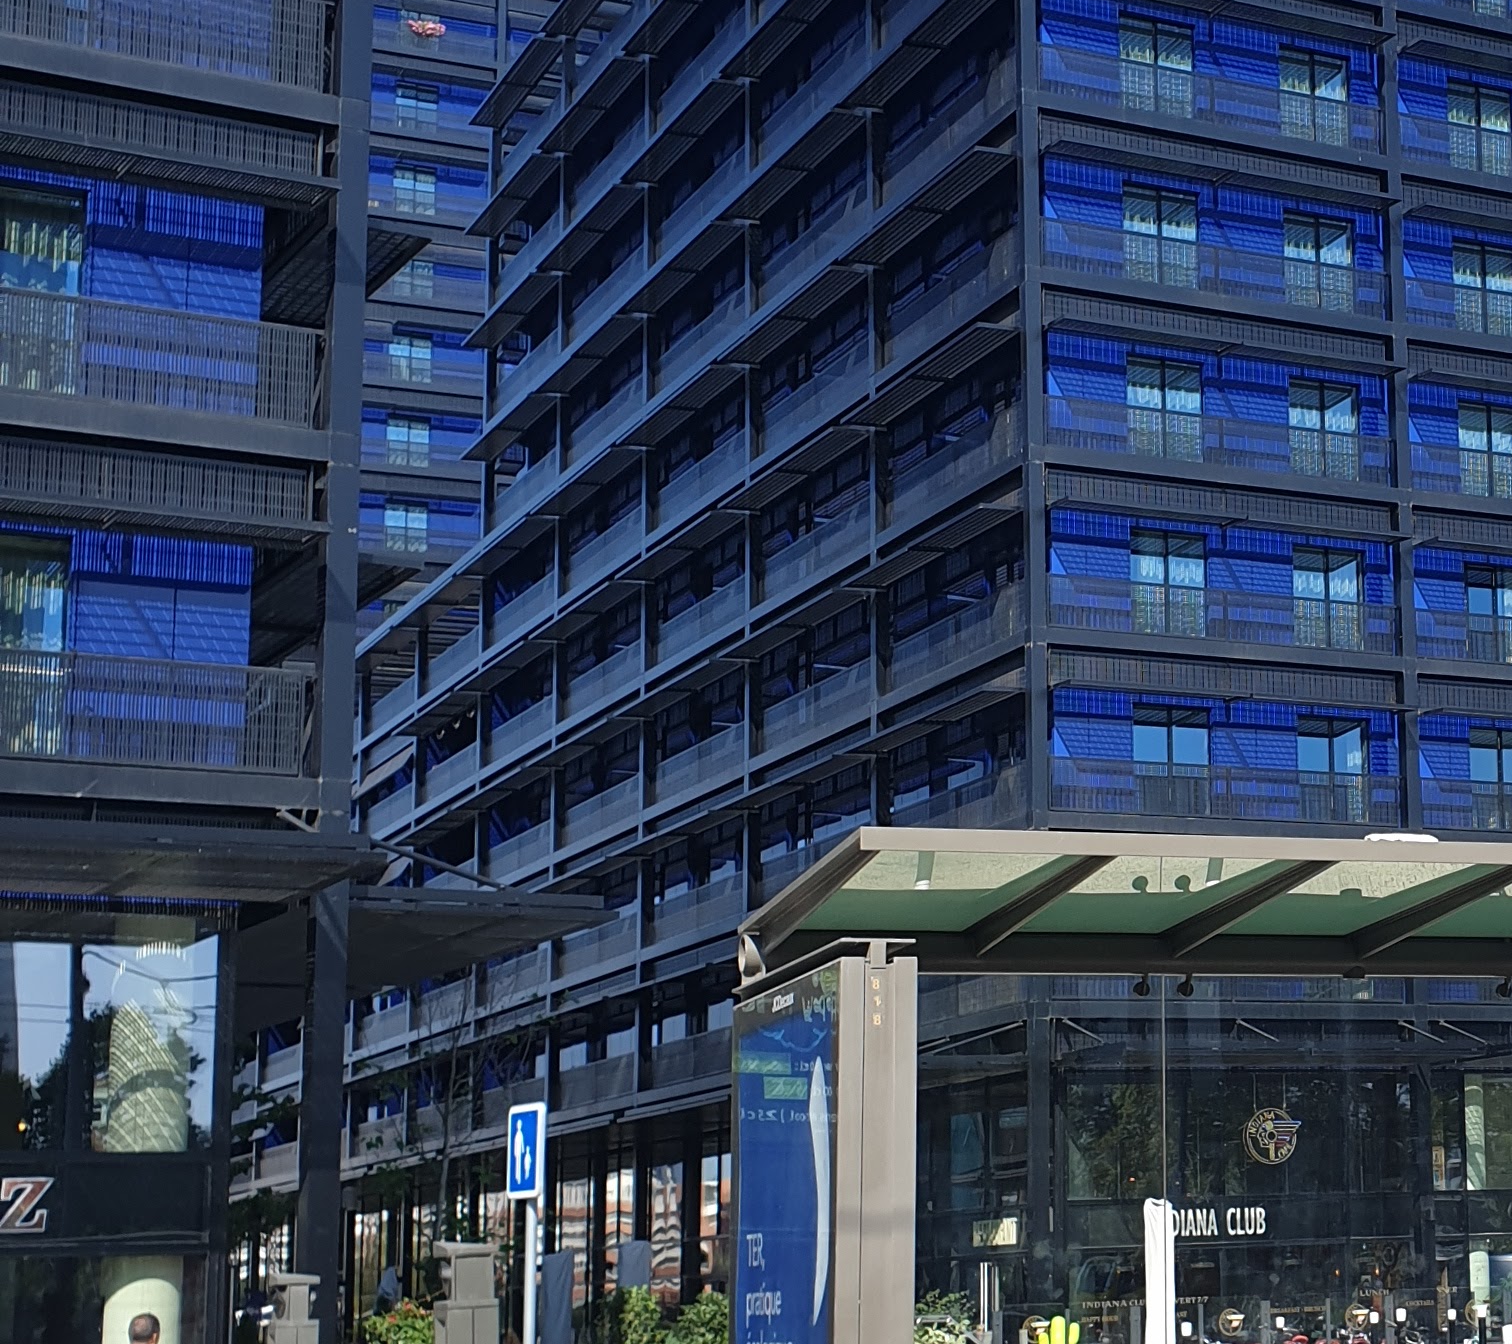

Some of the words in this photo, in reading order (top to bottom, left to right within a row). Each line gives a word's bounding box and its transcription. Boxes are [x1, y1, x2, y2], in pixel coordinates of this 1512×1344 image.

[1172, 1208, 1218, 1237] DIANA
[1226, 1207, 1266, 1236] CLUB
[746, 1232, 765, 1271] TER,
[745, 1282, 782, 1328] pratique
[1082, 1298, 1127, 1310] INDIANA
[1129, 1297, 1146, 1307] CLU
[1359, 1289, 1389, 1297] LUNCH
